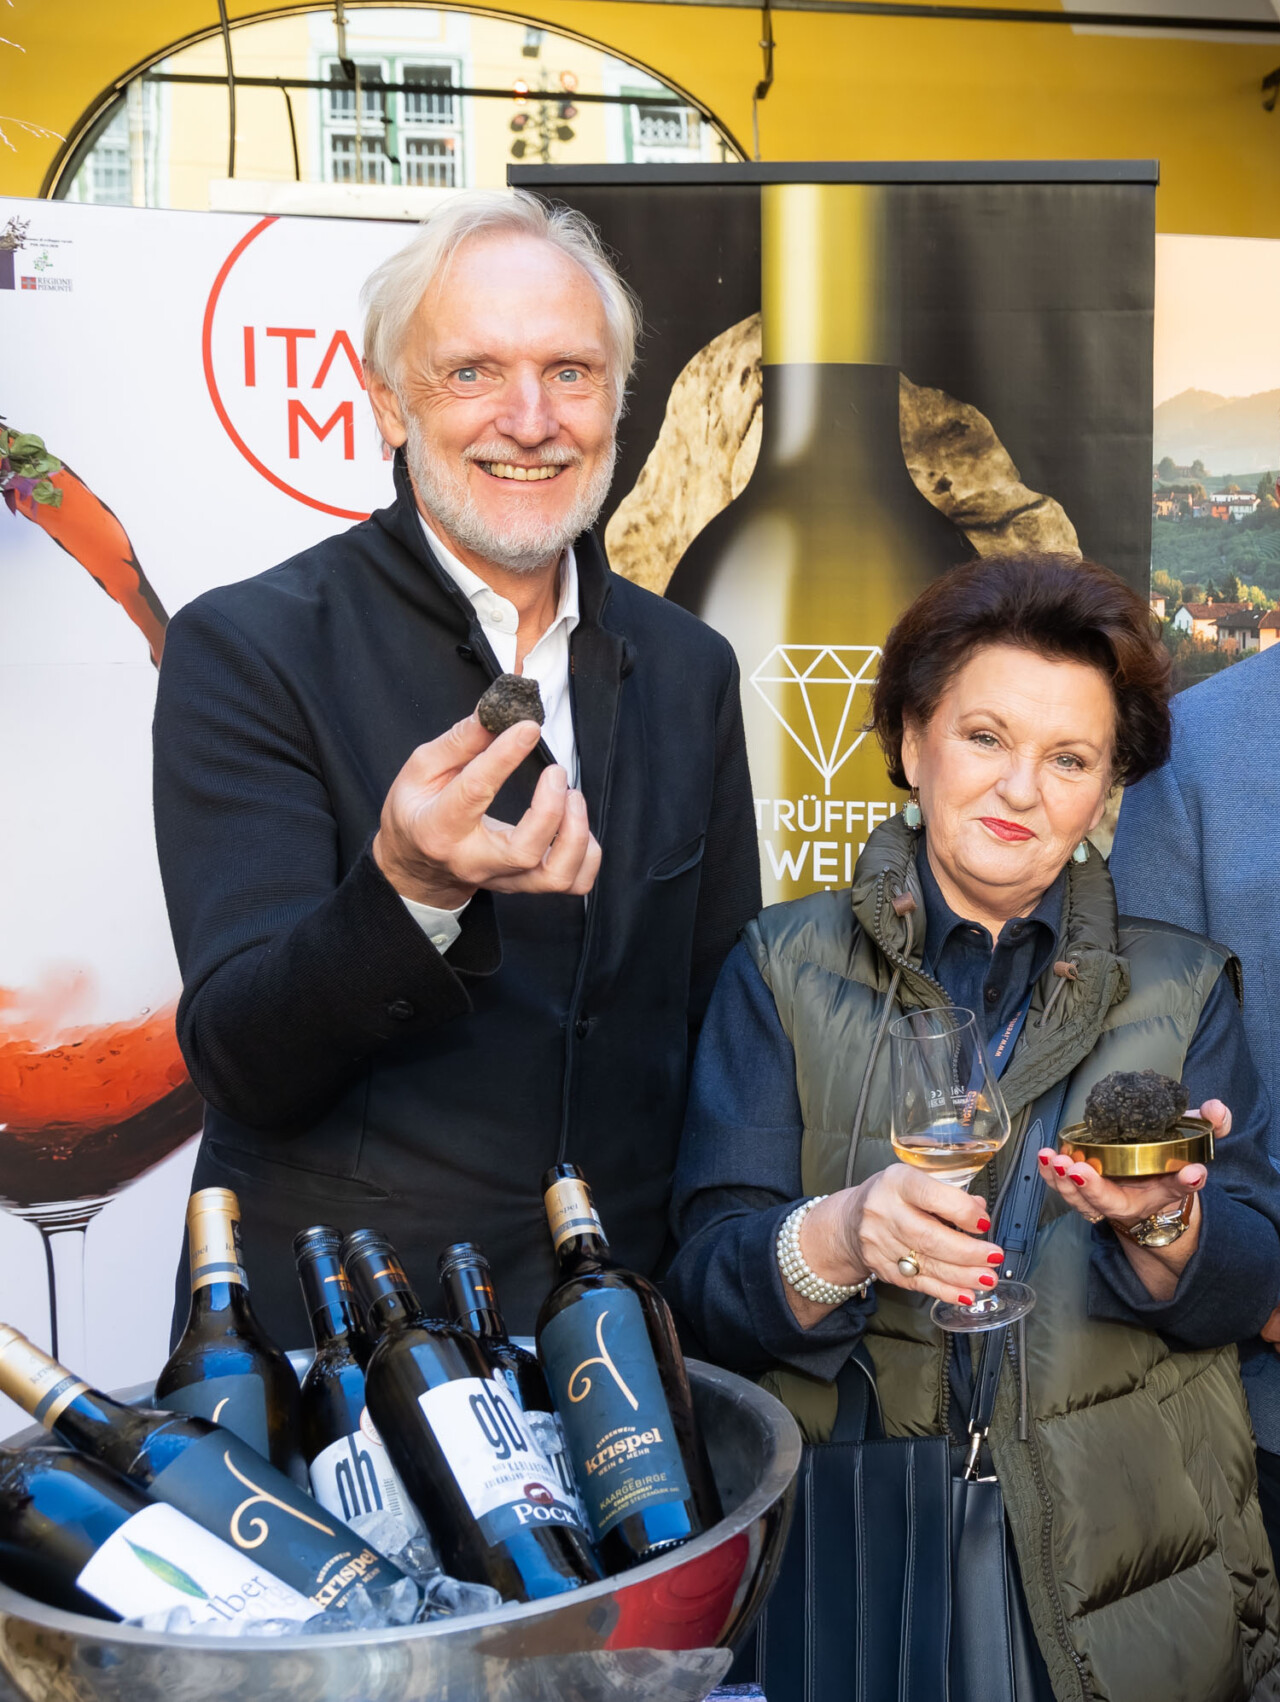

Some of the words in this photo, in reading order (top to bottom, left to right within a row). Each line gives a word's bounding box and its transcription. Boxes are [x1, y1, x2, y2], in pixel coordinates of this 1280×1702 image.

[764, 840, 866, 882] WEI
[585, 1428, 663, 1476] krispel
[598, 1461, 616, 1476] WEIN
[626, 1447, 650, 1460] MEHR
[600, 1472, 667, 1510] KAARGEBIRGE
[309, 1548, 378, 1609] krispel
